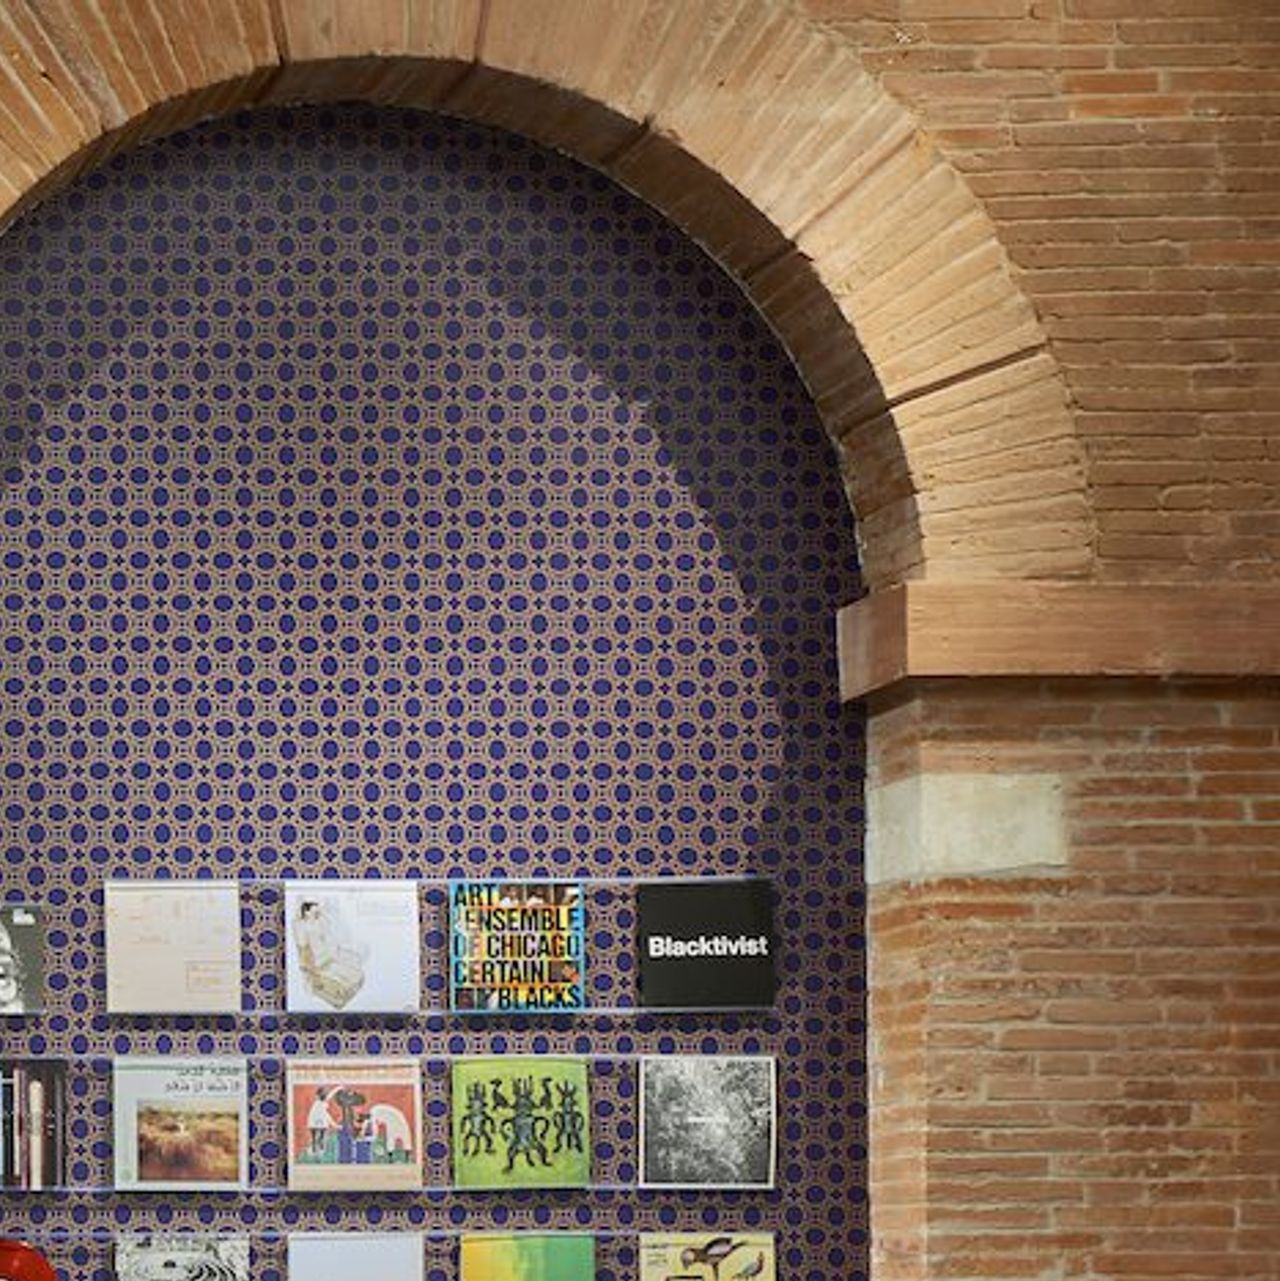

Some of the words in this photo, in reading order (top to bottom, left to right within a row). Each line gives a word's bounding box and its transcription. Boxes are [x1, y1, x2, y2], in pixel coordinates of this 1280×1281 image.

[454, 884, 496, 906] ART
[465, 907, 582, 931] ENSEMBLE
[488, 933, 580, 958] CHICAGO
[648, 935, 769, 957] Blacktivist
[454, 959, 544, 984] CERTAIN
[498, 985, 582, 1010] BLACKS
